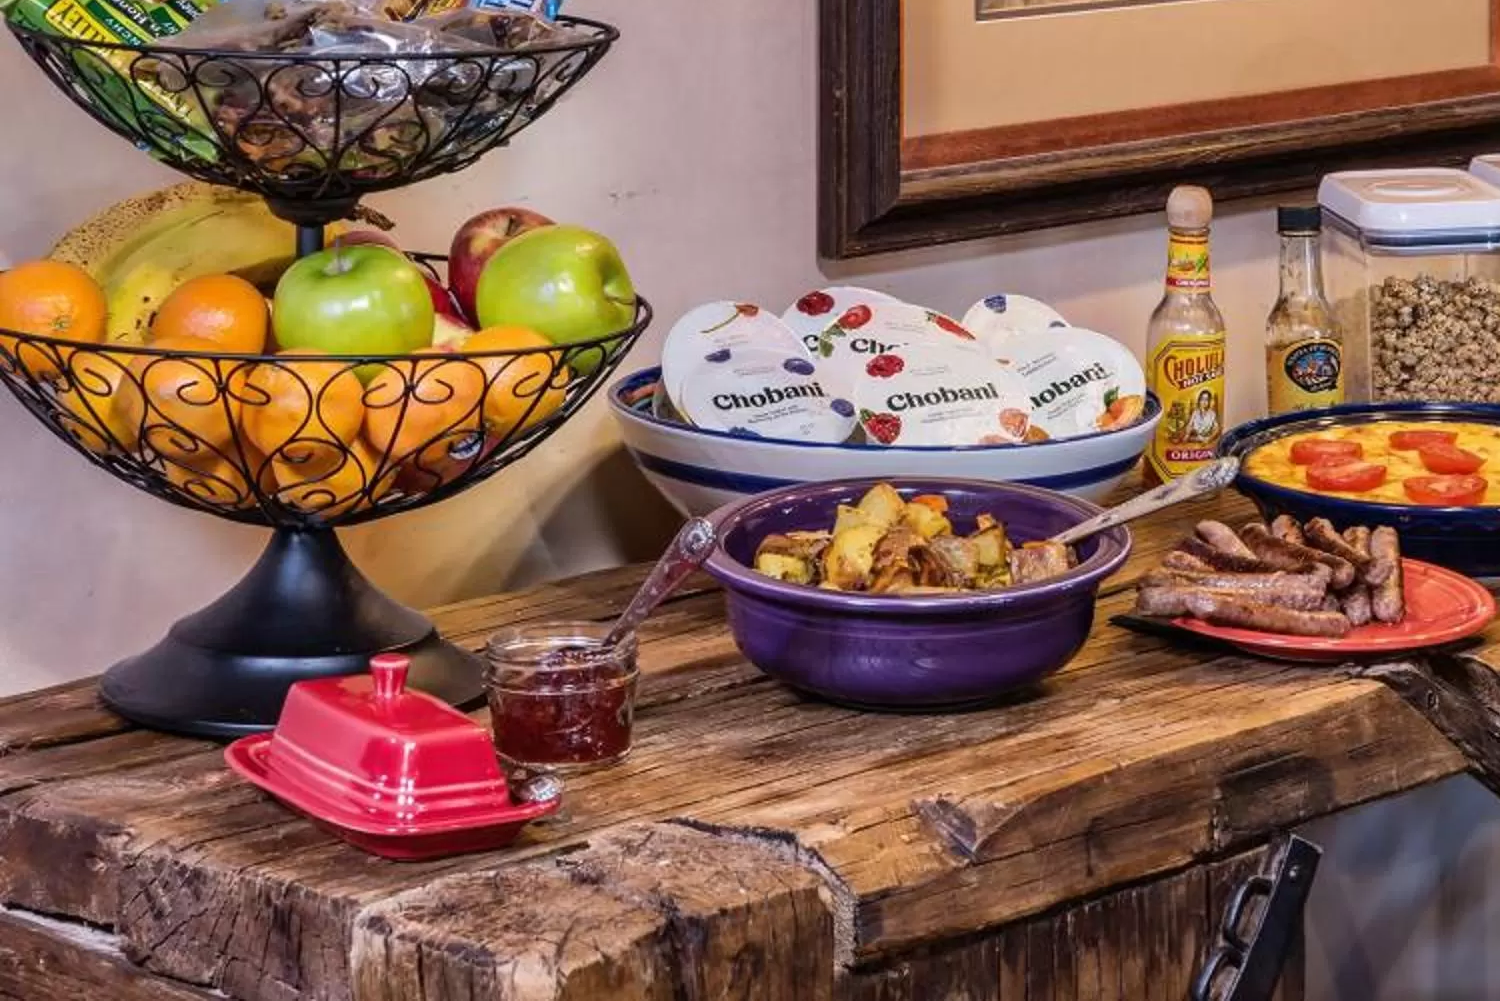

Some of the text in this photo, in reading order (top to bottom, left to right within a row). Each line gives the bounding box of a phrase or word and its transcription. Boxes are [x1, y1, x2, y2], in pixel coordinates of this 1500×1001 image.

[712, 381, 826, 411] Chobani
[886, 382, 999, 412] Chobani
[1029, 361, 1106, 411] obani
